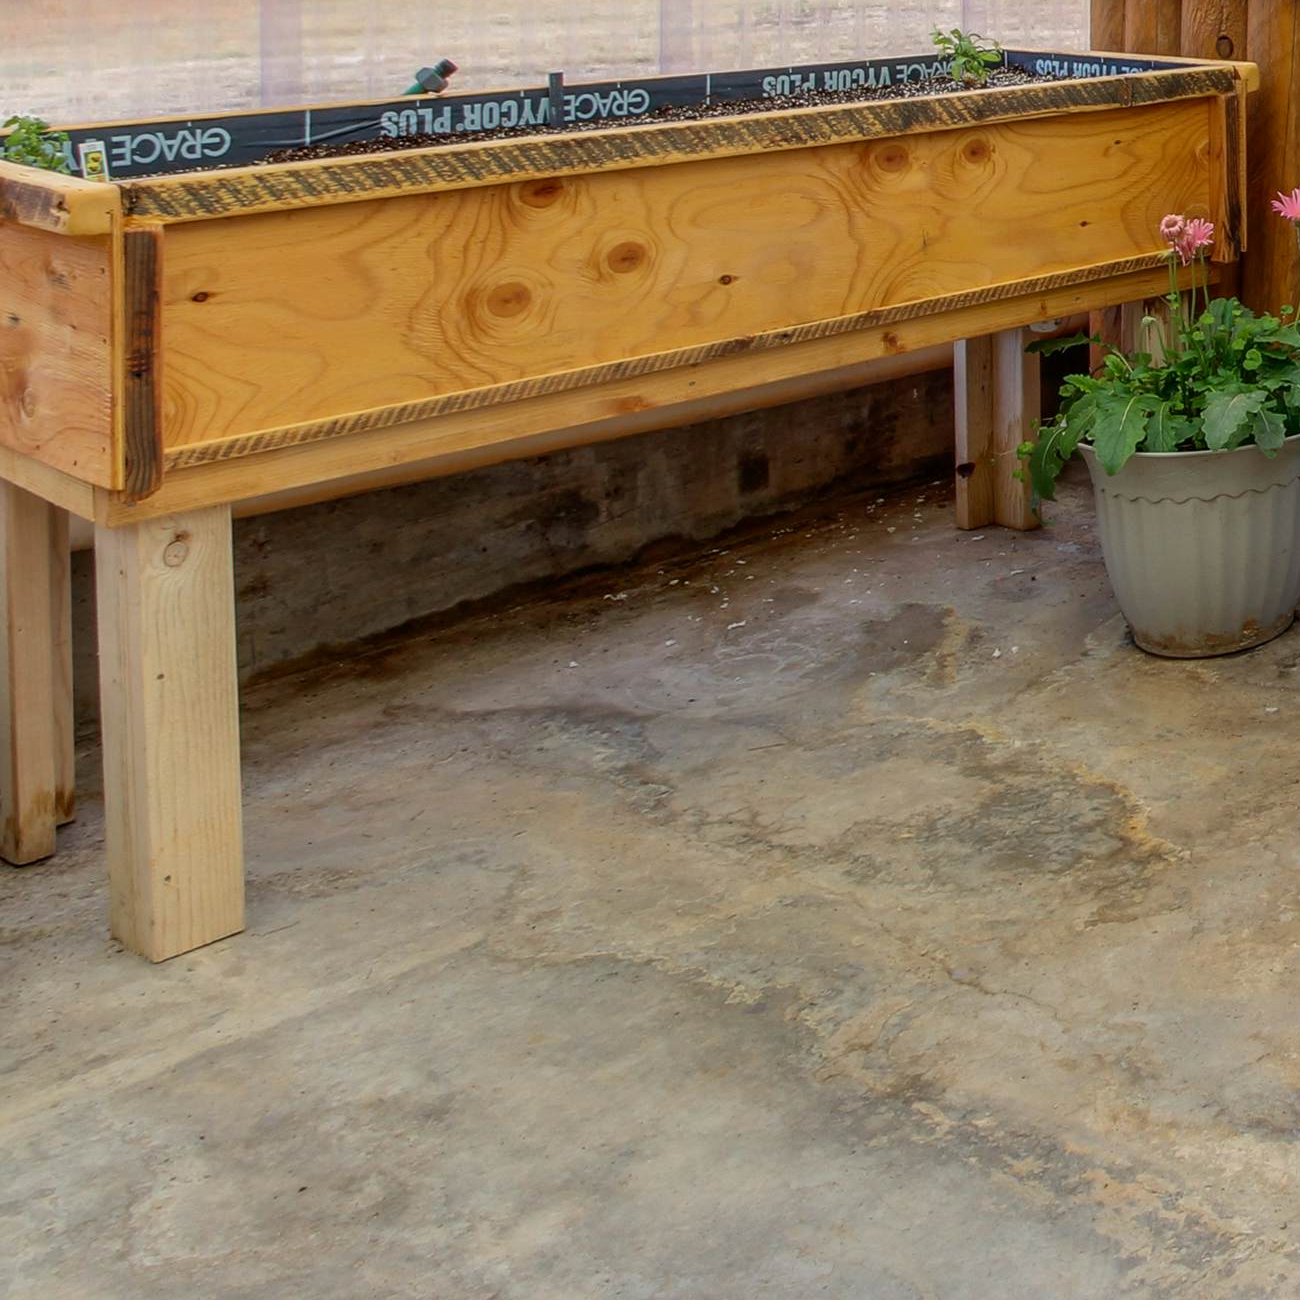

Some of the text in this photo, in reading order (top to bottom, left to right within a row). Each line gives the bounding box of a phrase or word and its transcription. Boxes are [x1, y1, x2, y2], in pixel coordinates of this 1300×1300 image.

[380, 104, 451, 138] PLUS
[563, 89, 650, 121] GRACE
[112, 127, 232, 167] GRACE
